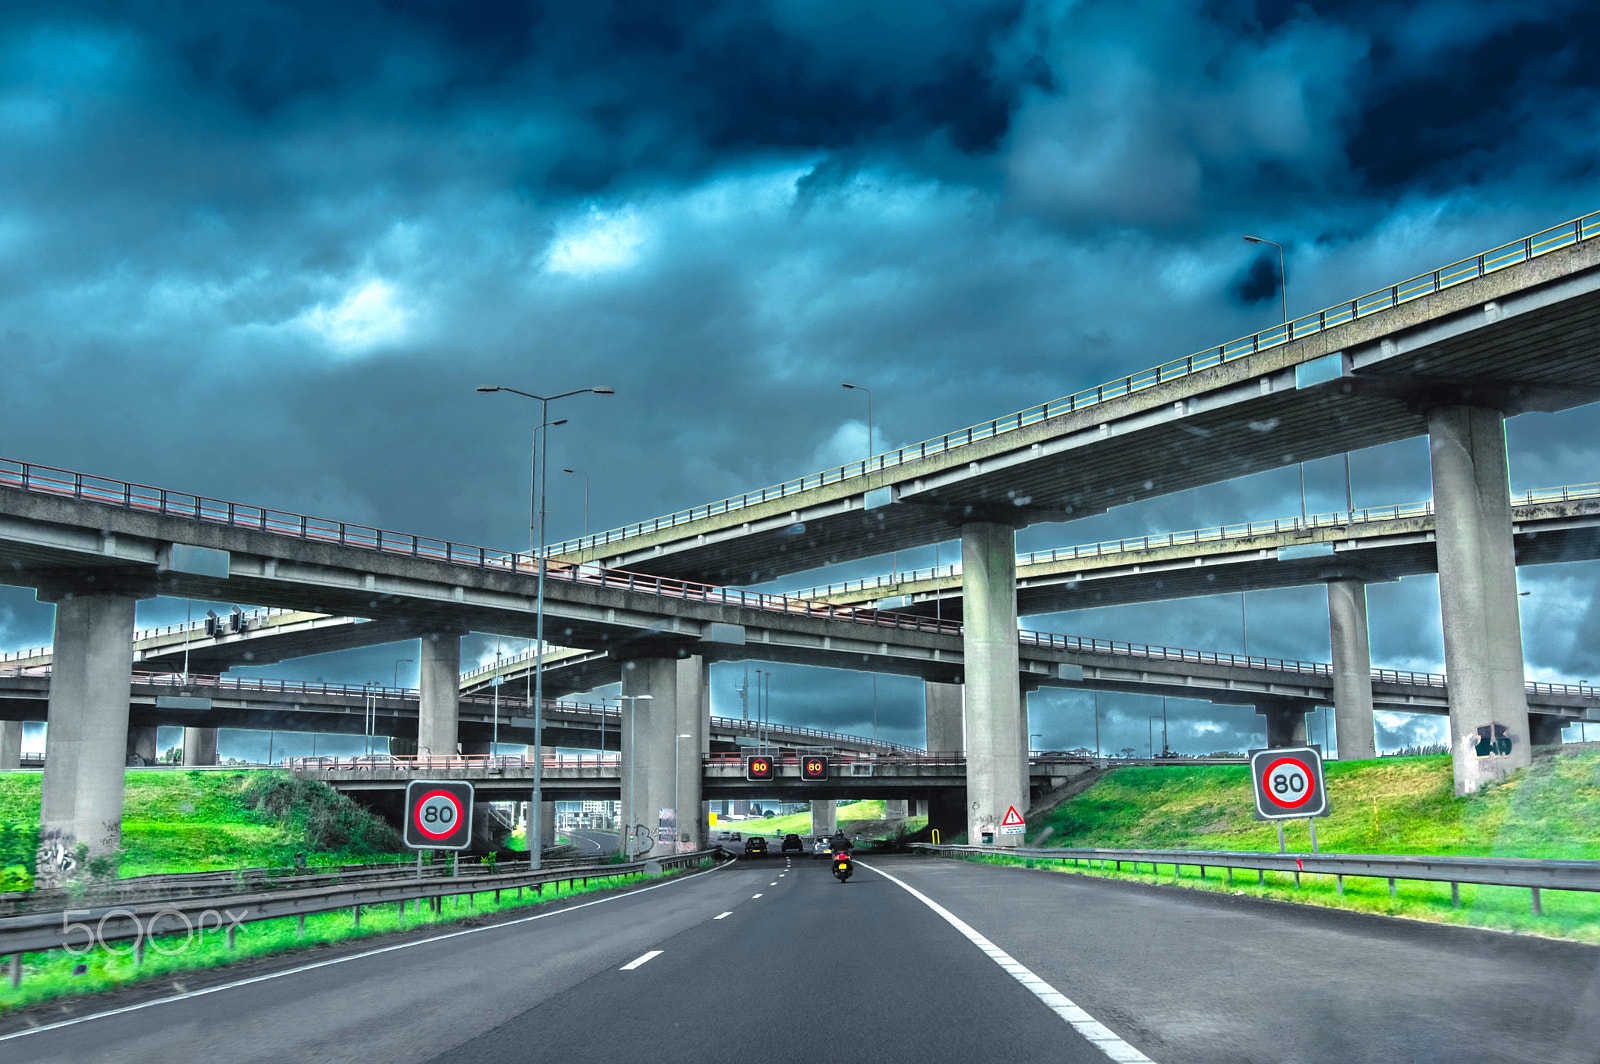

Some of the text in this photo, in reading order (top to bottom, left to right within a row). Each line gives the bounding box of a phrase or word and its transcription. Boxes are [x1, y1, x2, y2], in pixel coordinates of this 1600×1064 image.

[753, 763, 767, 771] 80
[808, 763, 821, 771] 80
[1273, 773, 1304, 794] 80
[424, 806, 454, 823] 80
